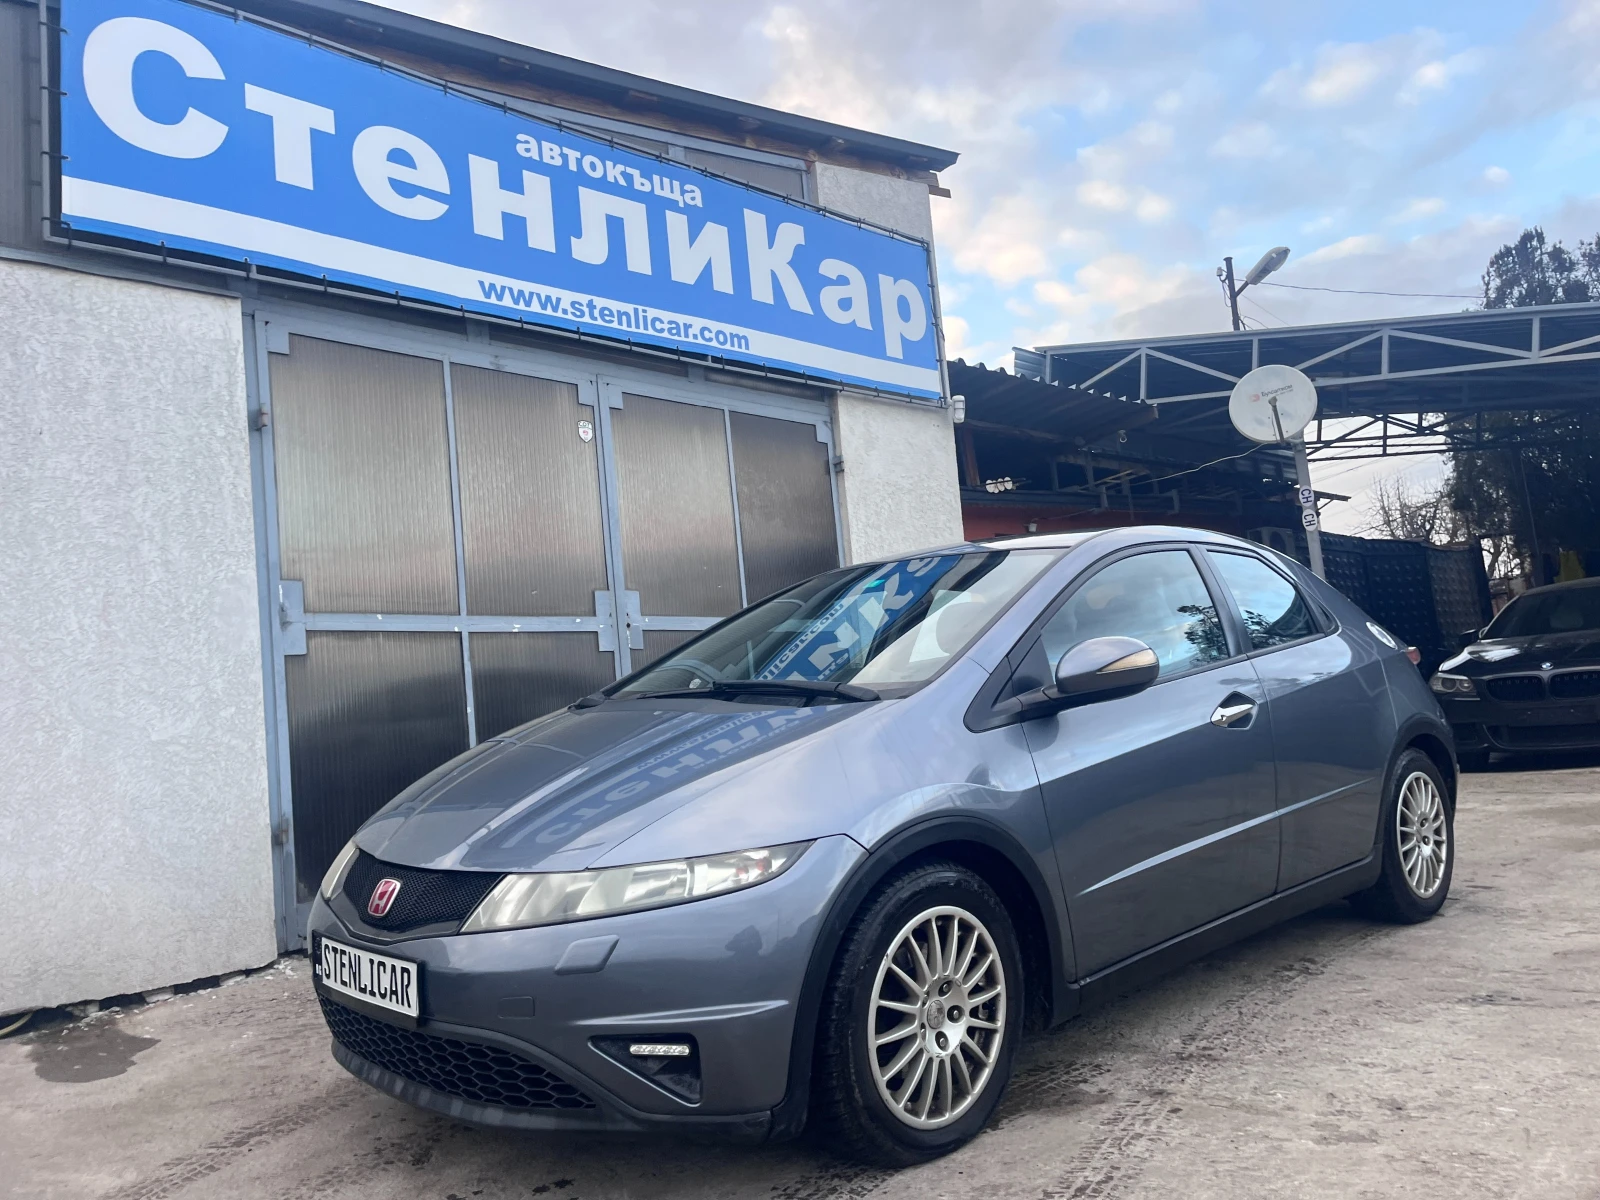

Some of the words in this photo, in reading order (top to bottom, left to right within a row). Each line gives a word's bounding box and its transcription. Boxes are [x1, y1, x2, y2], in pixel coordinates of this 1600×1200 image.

[83, 17, 927, 359] СтенлиКар
[516, 133, 703, 208] автокъща
[478, 279, 750, 353] www.stenlicar.com
[1301, 488, 1313, 504] CH
[1304, 513, 1316, 527] CH
[324, 943, 412, 1009] STENLICAR
